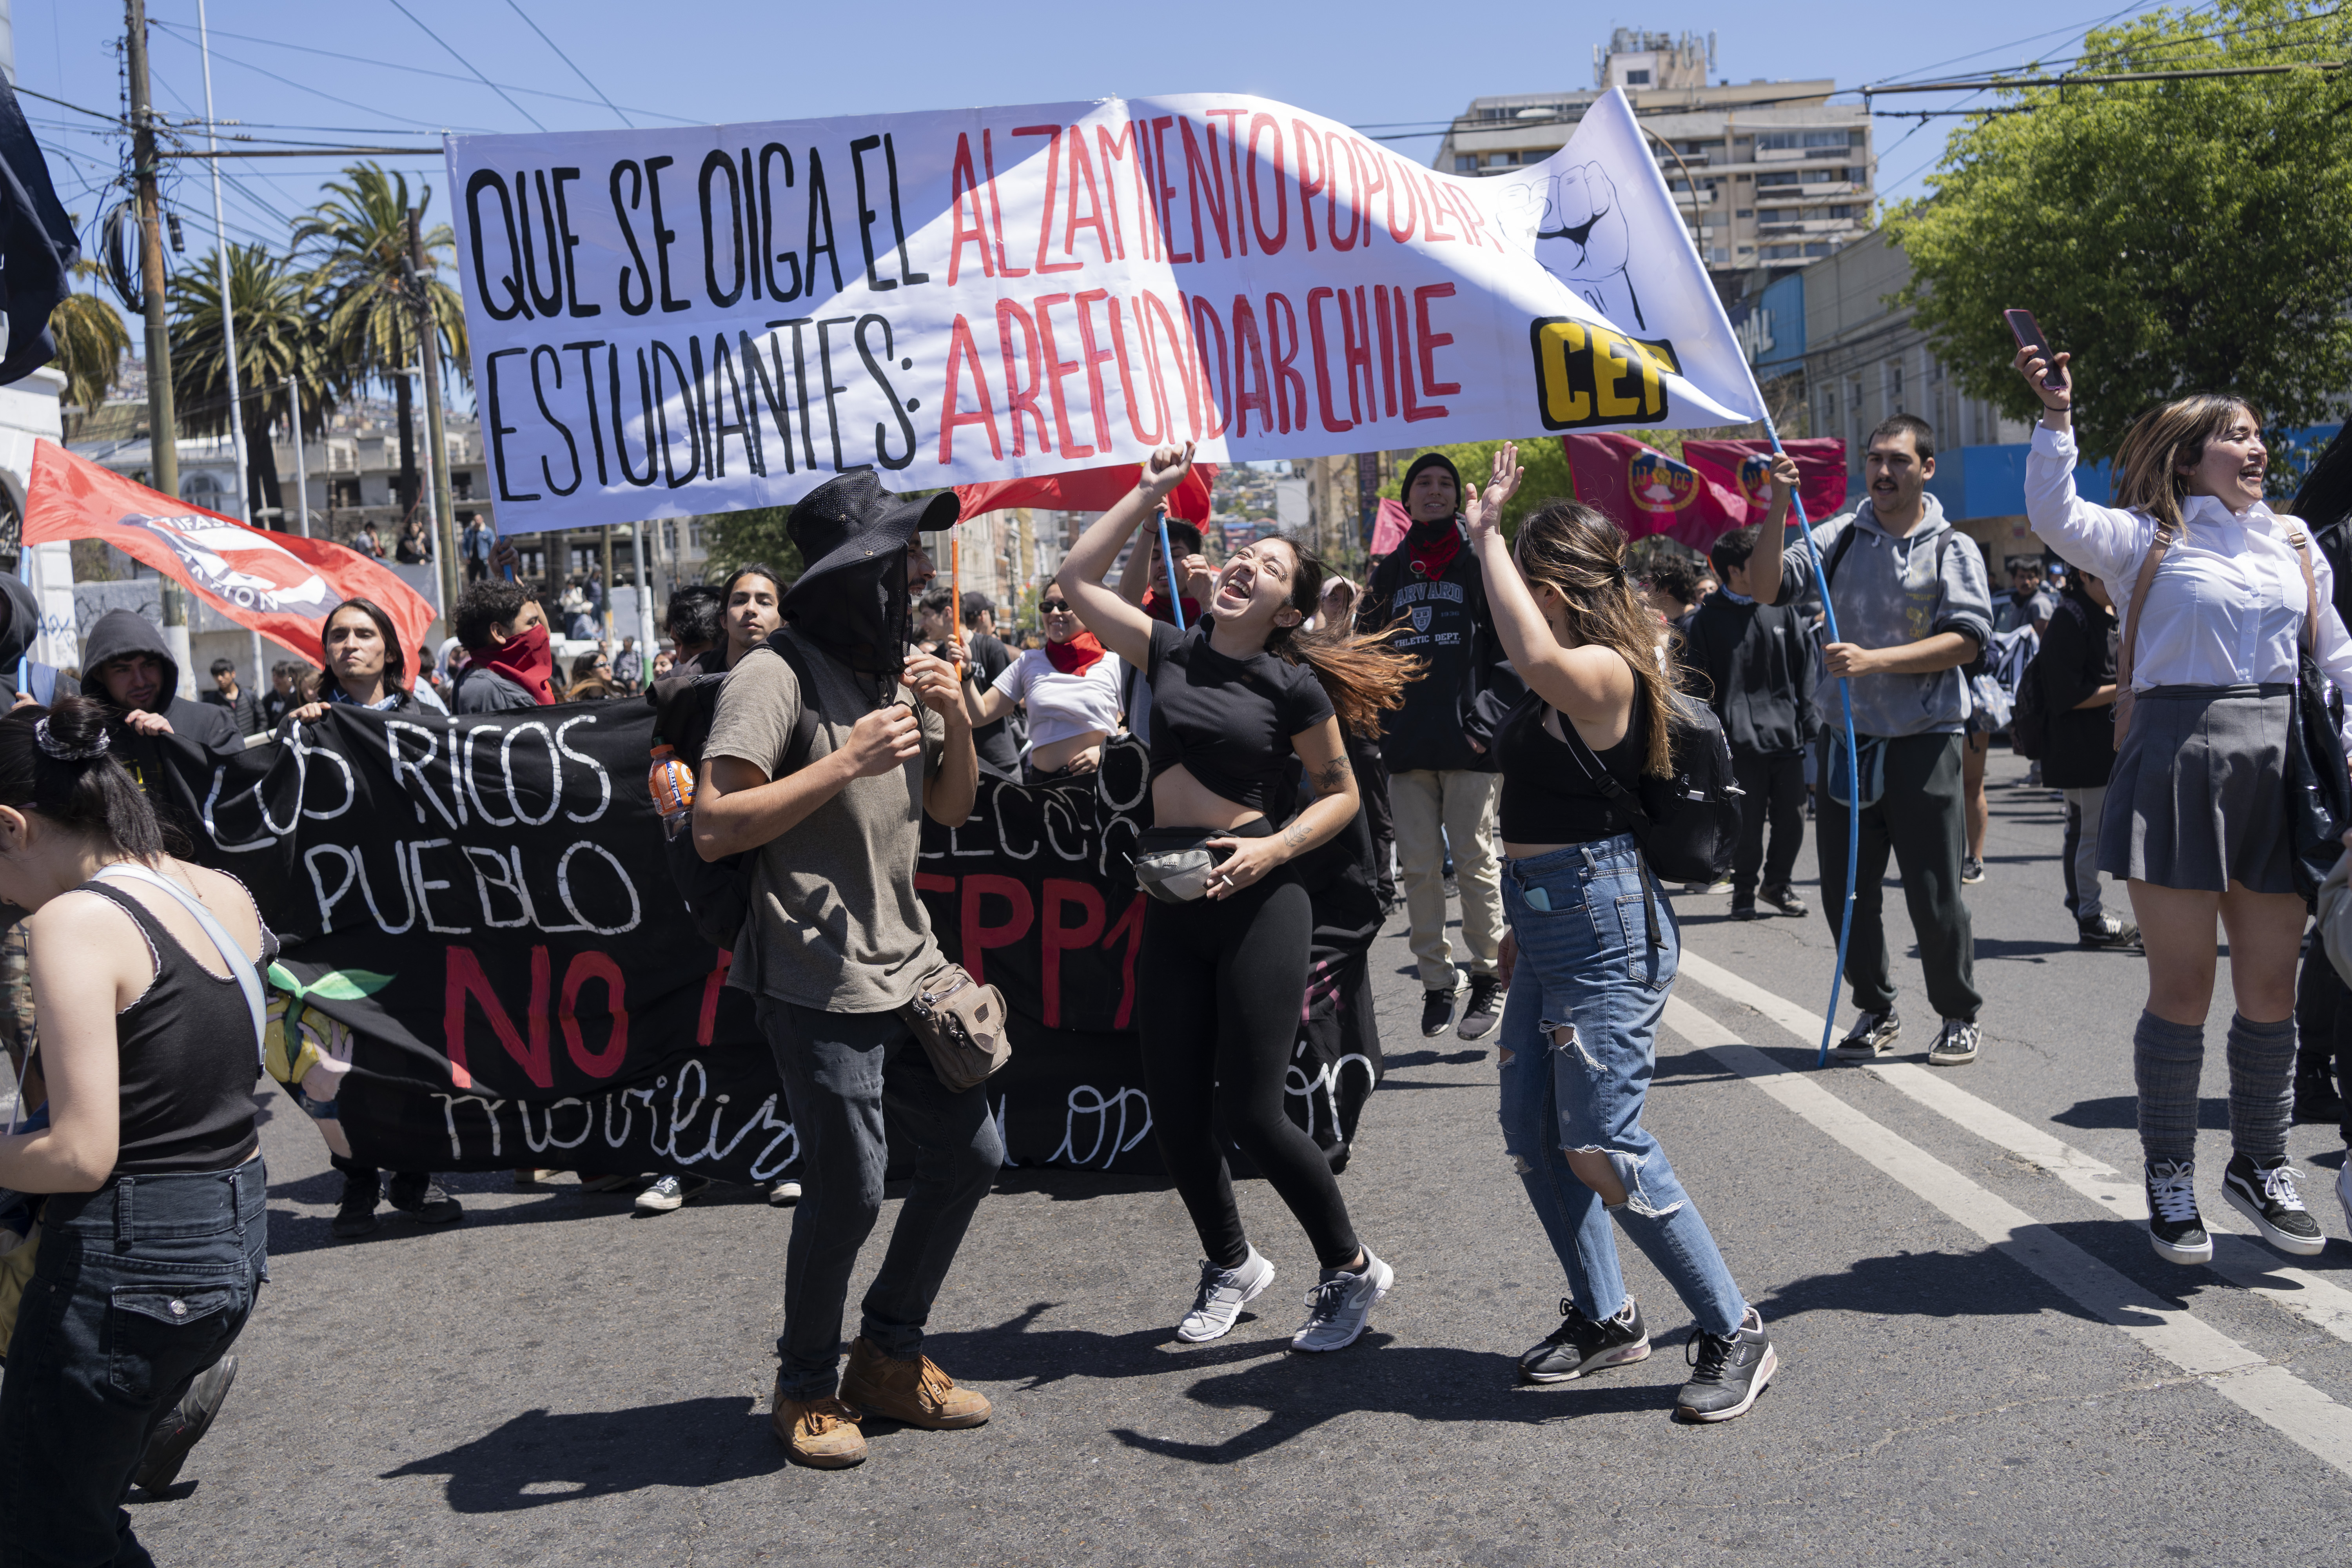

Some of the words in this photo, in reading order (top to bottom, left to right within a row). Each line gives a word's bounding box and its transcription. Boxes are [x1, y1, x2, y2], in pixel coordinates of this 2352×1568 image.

[466, 166, 601, 321] QUE
[610, 155, 691, 316] SE
[698, 142, 843, 308] OIGA
[851, 132, 929, 291] EL
[947, 109, 1287, 286] ALZAMIENTO
[1292, 118, 1505, 254] POPULAR
[487, 314, 920, 502] ESTUDIANTES:
[939, 313, 1004, 465] A
[996, 288, 1307, 460] REFUNDAR
[1308, 281, 1461, 433] CHILE
[1394, 635, 1430, 647] THLETIC
[1434, 632, 1461, 642] DEPT.
[668, 767, 678, 791] LITRO
[304, 839, 642, 935] PUEBLO
[443, 944, 629, 1088] NO
